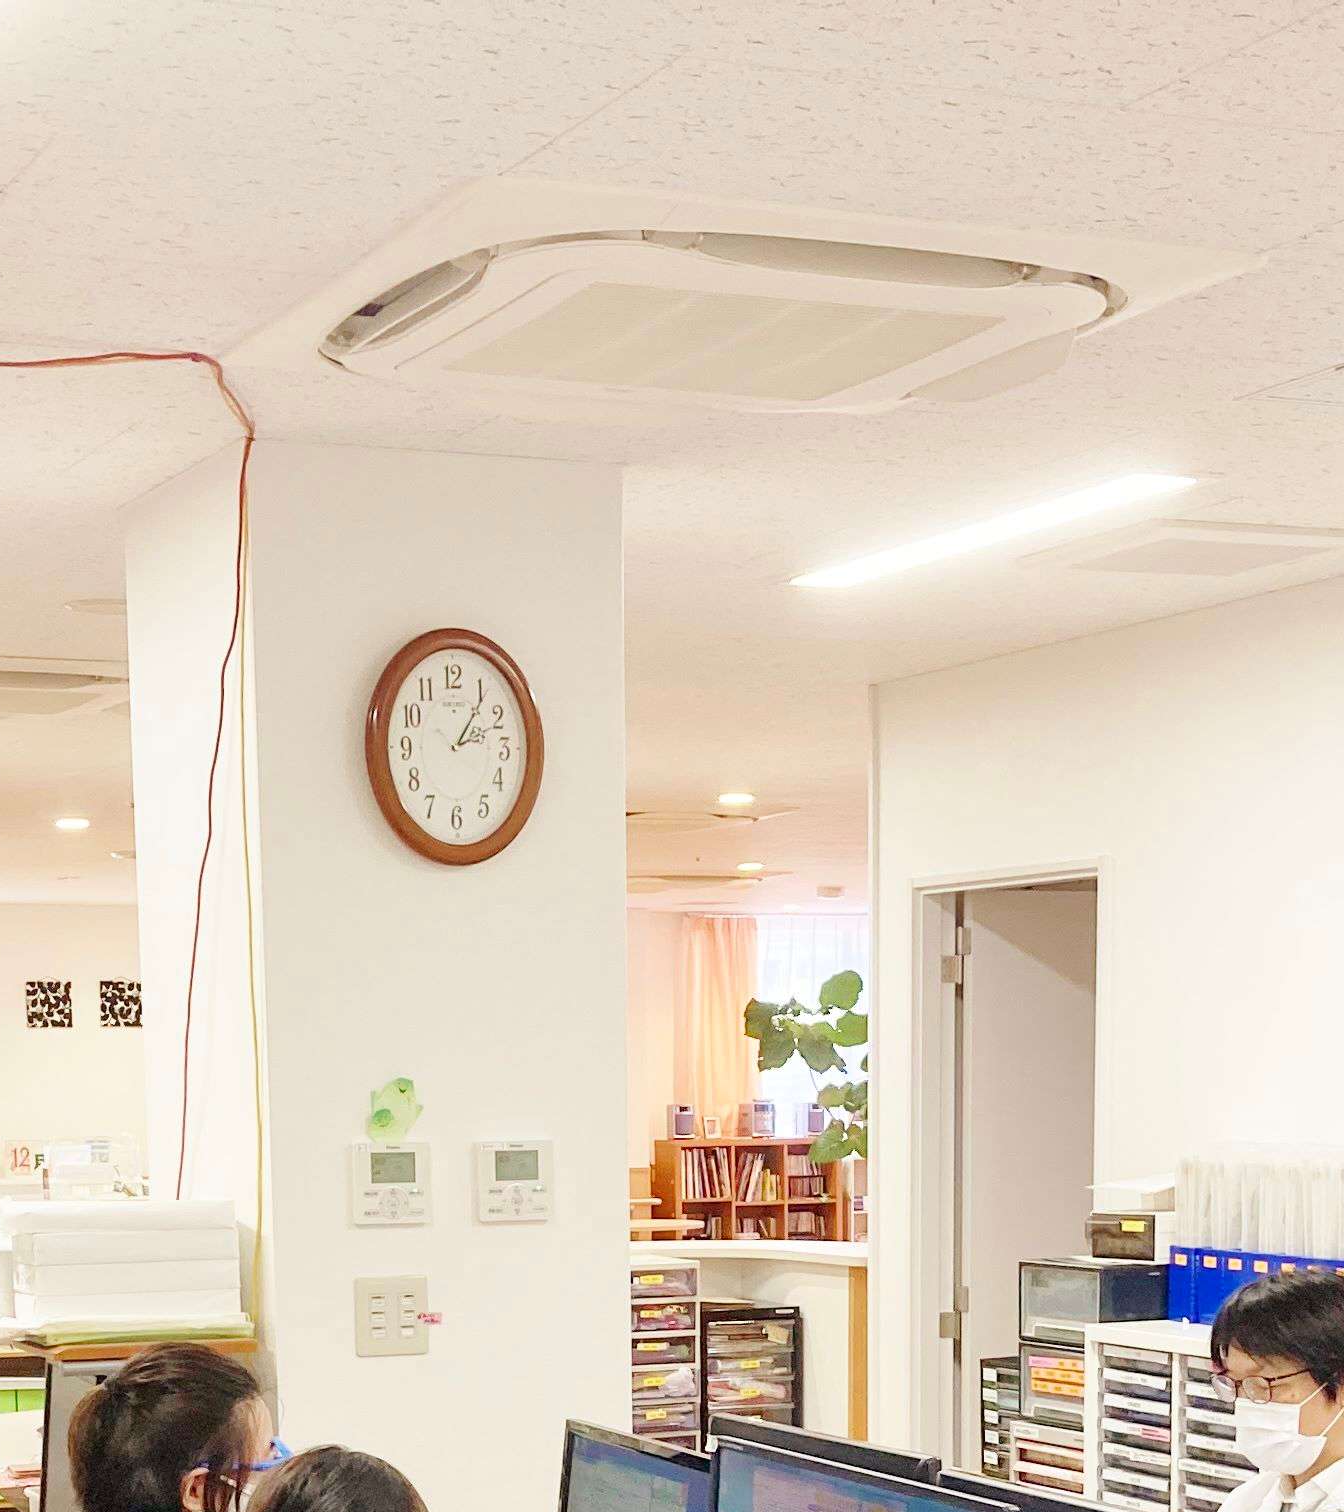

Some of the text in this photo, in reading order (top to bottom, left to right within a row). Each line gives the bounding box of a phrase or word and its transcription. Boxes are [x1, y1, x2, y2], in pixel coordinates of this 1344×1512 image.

[418, 677, 433, 701] 11
[443, 664, 462, 690] 12
[476, 678, 484, 702] 1
[403, 703, 421, 729] 10
[492, 704, 504, 729] 2
[400, 736, 413, 761] 9
[498, 736, 511, 761] 3
[408, 767, 421, 792] 8
[491, 767, 503, 792] 4
[424, 794, 435, 819] 7
[450, 805, 463, 831] 6
[478, 794, 490, 819] 5
